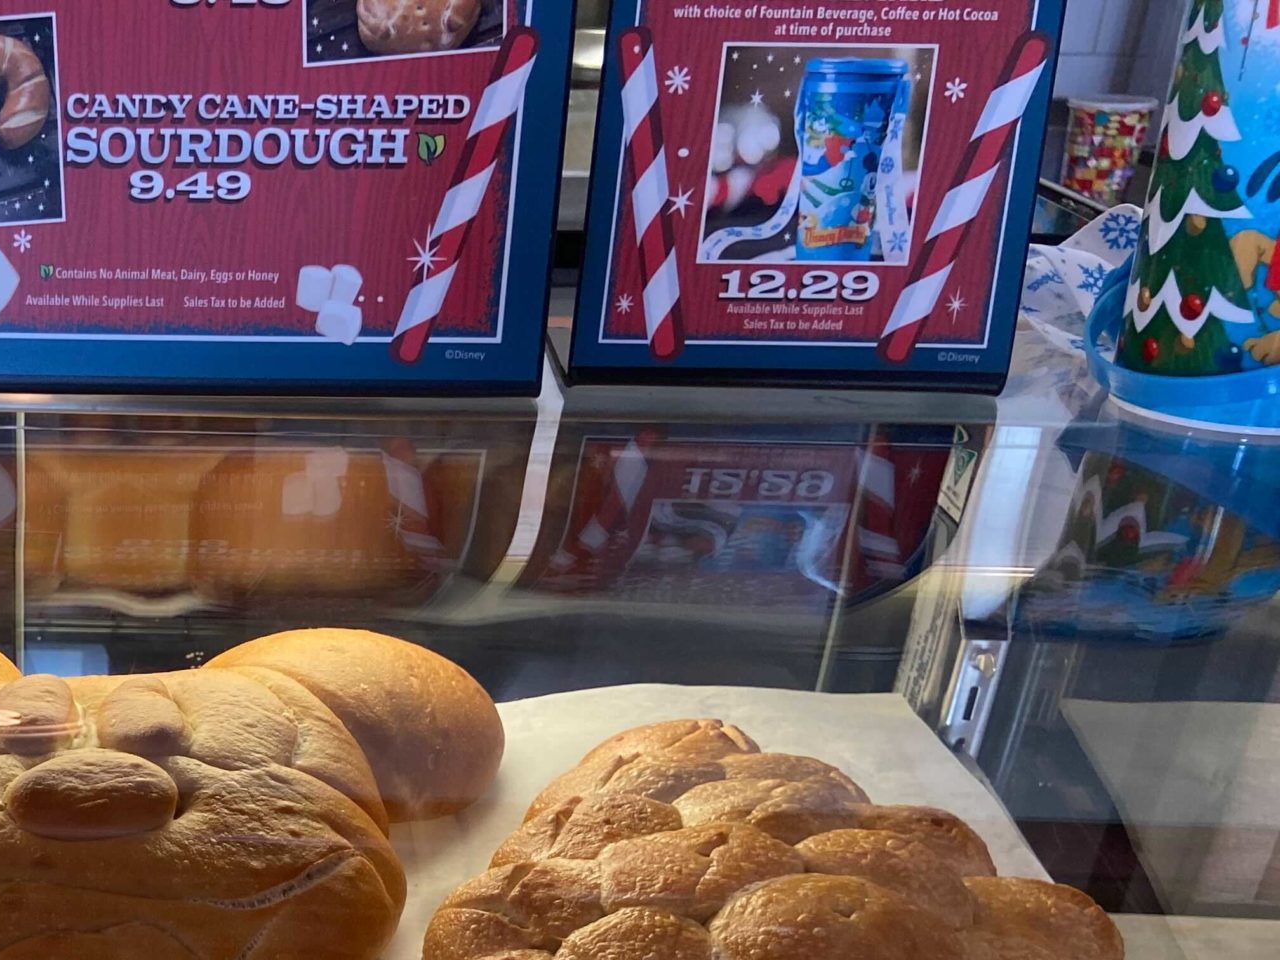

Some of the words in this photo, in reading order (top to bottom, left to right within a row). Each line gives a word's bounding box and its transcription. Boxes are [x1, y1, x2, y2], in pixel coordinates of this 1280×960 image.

[673, 6, 702, 18] with
[704, 6, 742, 19] choice
[744, 6, 758, 20] of
[759, 6, 814, 20] Fountain
[817, 7, 878, 23] Beverage,
[880, 7, 920, 21] Coffee
[922, 10, 936, 21] or
[938, 8, 960, 21] Hot
[963, 8, 999, 21] Cocoa
[774, 25, 786, 36] at
[789, 24, 818, 36] time
[820, 24, 834, 37] of
[835, 25, 892, 40] purchase
[66, 94, 193, 120] CANDY
[198, 94, 471, 120] CANE-SHAPED
[66, 127, 410, 164] SOURDOUGH
[129, 171, 251, 200] 9.49
[55, 267, 97, 280] Contains
[99, 268, 113, 280] No
[114, 268, 149, 280] Animal
[151, 269, 178, 282] Meat,
[180, 269, 208, 283] Dairy,
[210, 269, 233, 283] Eggs
[235, 272, 246, 280] or
[248, 269, 279, 284] Honey
[718, 269, 880, 301] 12.29
[26, 294, 70, 306] Available
[72, 295, 100, 307] While
[102, 295, 144, 309] Supplies
[145, 296, 165, 307] Last
[183, 296, 208, 308] Sales
[210, 297, 226, 308] Tax
[227, 298, 238, 308] to
[239, 297, 252, 308] be
[253, 297, 285, 309] Added
[726, 304, 771, 315] Available
[772, 304, 800, 315] While
[802, 305, 843, 318] Supplies
[844, 305, 864, 316] Last
[743, 319, 768, 330] Sales
[769, 319, 786, 330] Tax
[786, 321, 797, 330] to
[798, 320, 810, 330] be
[811, 320, 843, 331] Added
[445, 349, 486, 362] ©Disney
